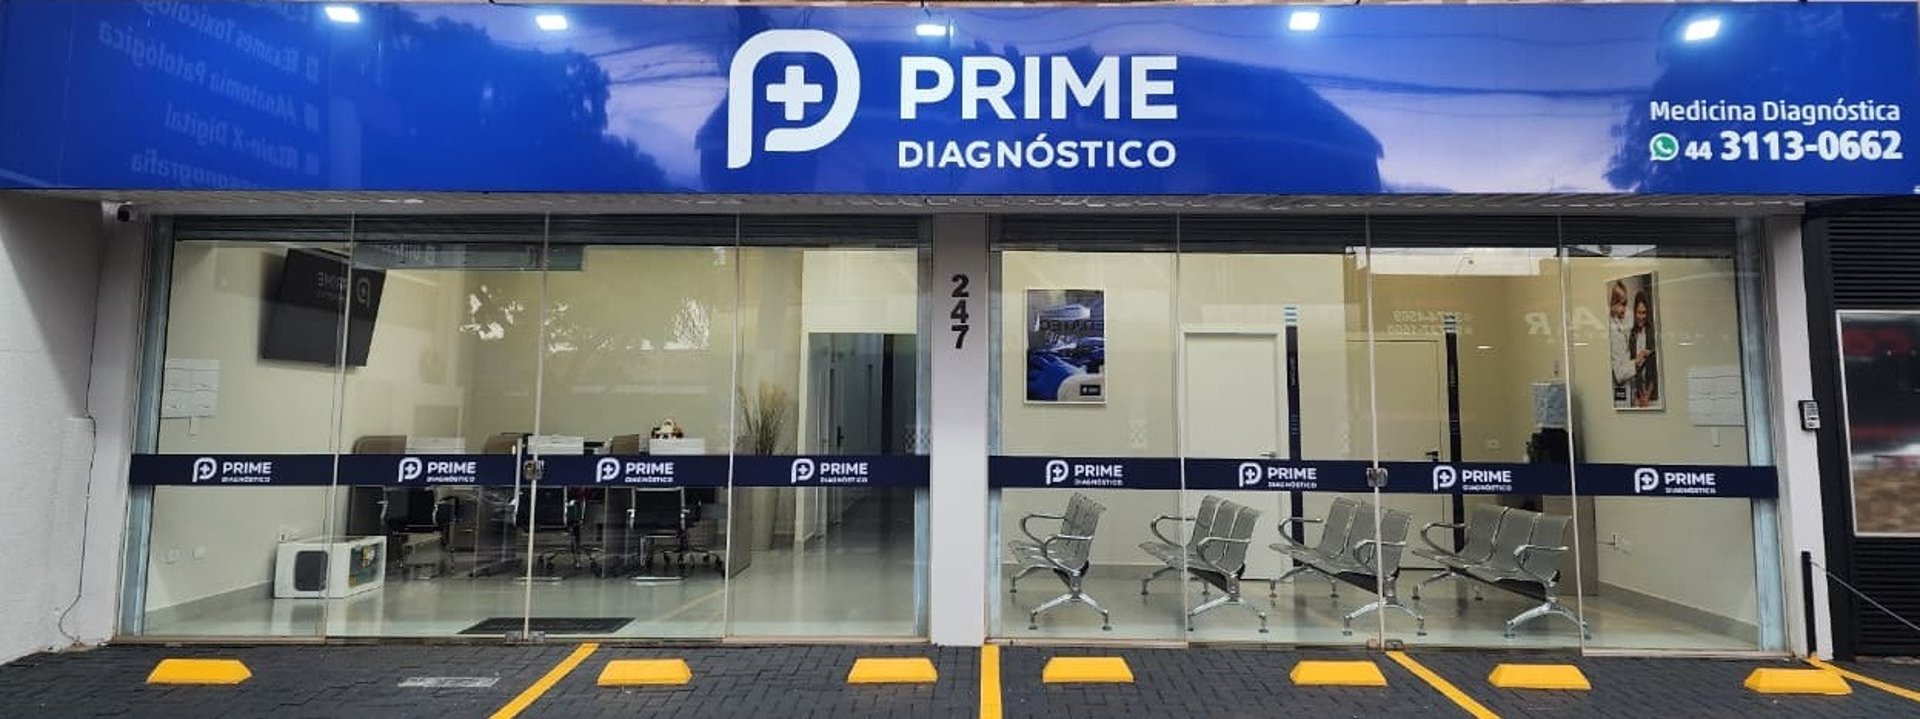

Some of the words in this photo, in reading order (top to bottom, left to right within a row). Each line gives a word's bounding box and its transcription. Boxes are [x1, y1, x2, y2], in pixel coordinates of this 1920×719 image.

[901, 56, 1177, 119] PRIME
[1650, 100, 1755, 121] Medicina
[1763, 98, 1901, 125] Diagnóstica
[899, 133, 1176, 168] DIAGNÓSTICO
[1685, 142, 1712, 160] 44
[1721, 131, 1903, 161] 3113-0662
[950, 273, 970, 348] 247
[223, 462, 272, 474] PRIME
[427, 462, 476, 474] PRIME
[625, 462, 674, 475] PRIME
[820, 463, 868, 475] PRIME
[1075, 465, 1123, 477] PRIME
[1268, 467, 1317, 480] PRIME
[1462, 470, 1512, 483] PRIME
[1664, 473, 1716, 485] PRIME
